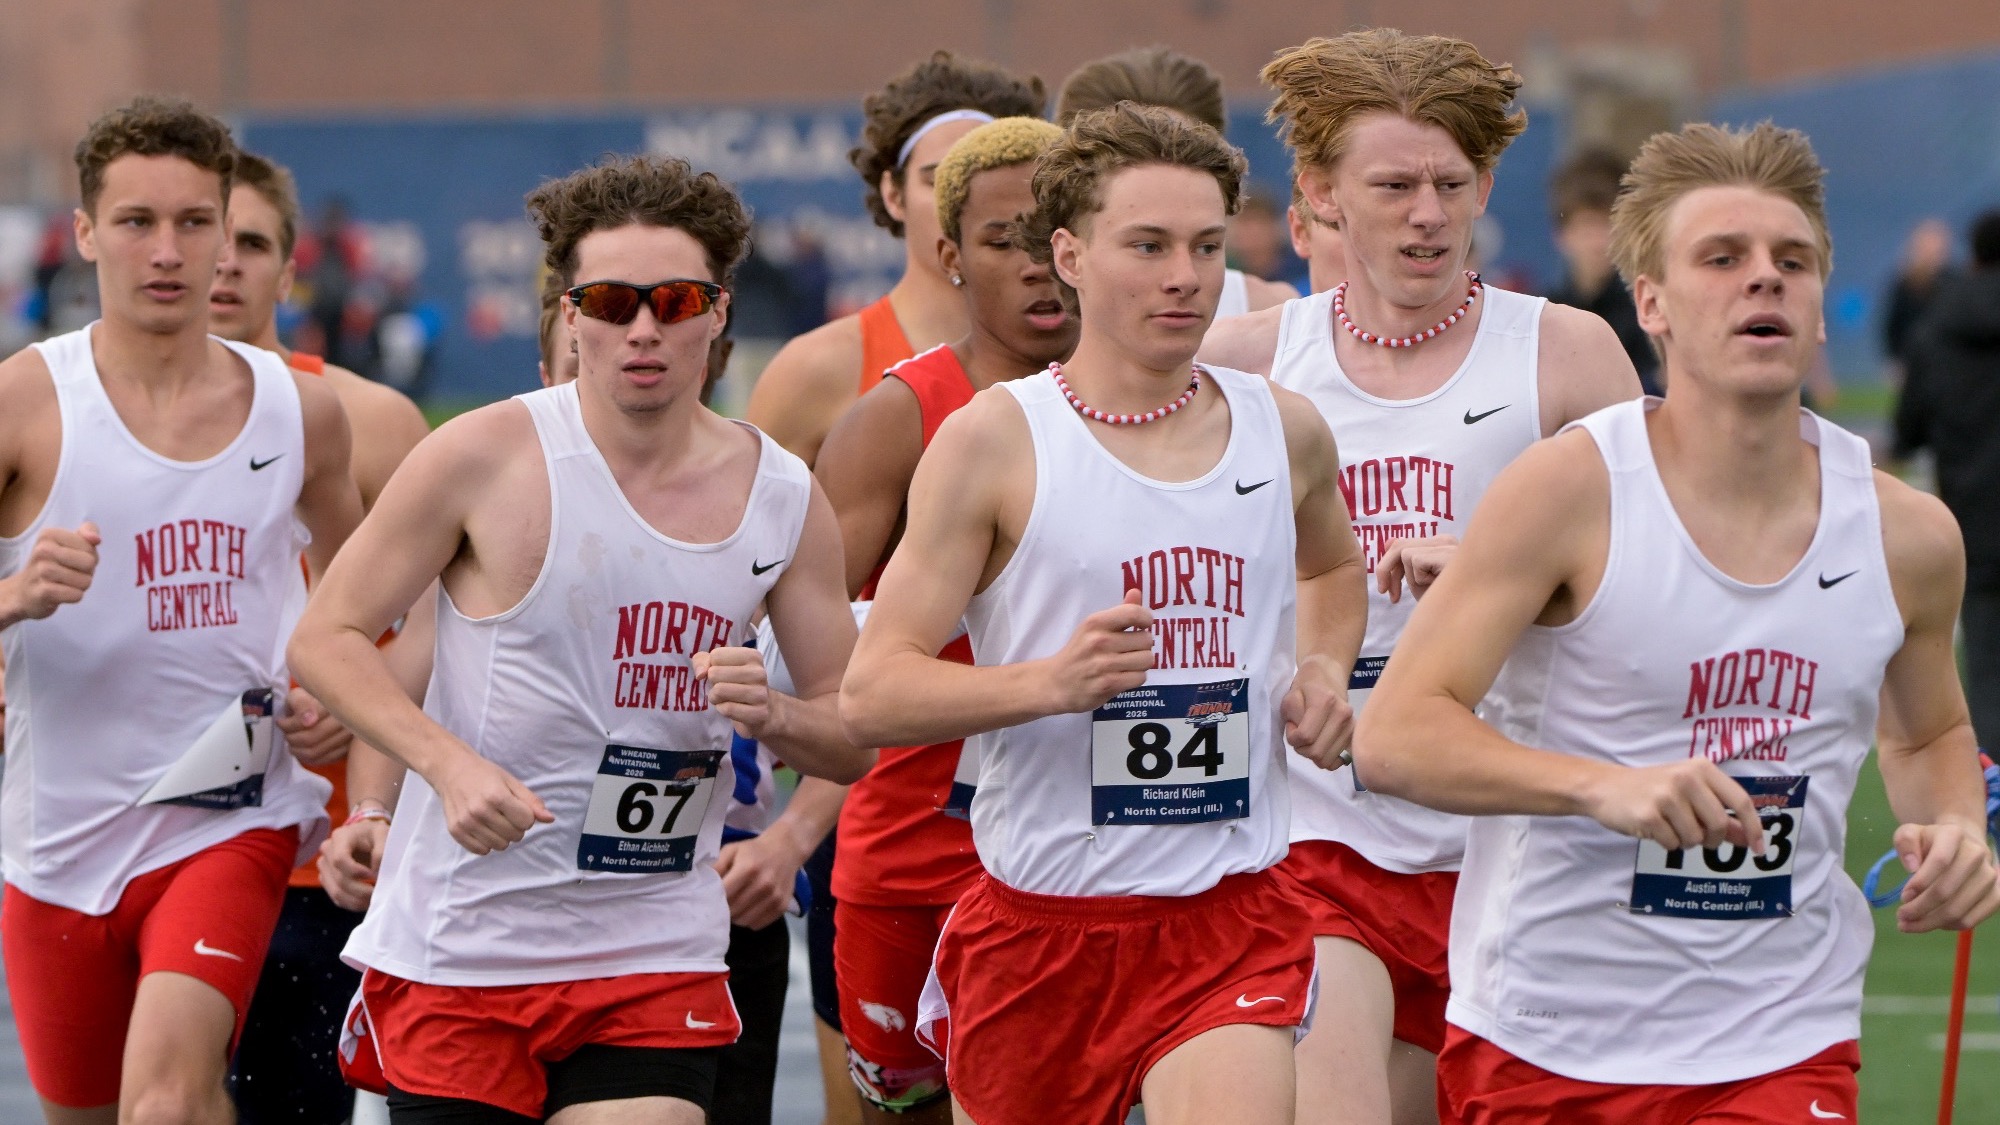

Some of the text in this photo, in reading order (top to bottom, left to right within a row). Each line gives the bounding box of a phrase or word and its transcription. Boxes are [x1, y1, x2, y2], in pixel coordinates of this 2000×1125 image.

[1338, 455, 1454, 521] NORTH
[135, 519, 247, 587] NORTH
[1121, 546, 1245, 618] NORTH
[147, 580, 238, 632] CENTRAL
[613, 601, 734, 660] NORTH
[1146, 616, 1235, 670] ENTRAL
[1117, 690, 1158, 699] WHEATON
[1683, 648, 1819, 720] NORTH
[1125, 710, 1148, 718] 2026
[621, 749, 658, 760] WHEATON
[1126, 722, 1224, 780] 84
[1689, 717, 1793, 765] CENTRAL
[624, 768, 645, 778] 2026
[616, 782, 696, 834] 67
[1124, 803, 1223, 816] North Central (Ill.)
[1142, 787, 1206, 800] Richard Klein
[601, 855, 628, 866] North
[630, 858, 661, 867] Central
[618, 840, 640, 852] Ethan
[1664, 898, 1699, 909] North
[1702, 900, 1744, 911] Central
[1684, 881, 1752, 897] Austin Wesley
